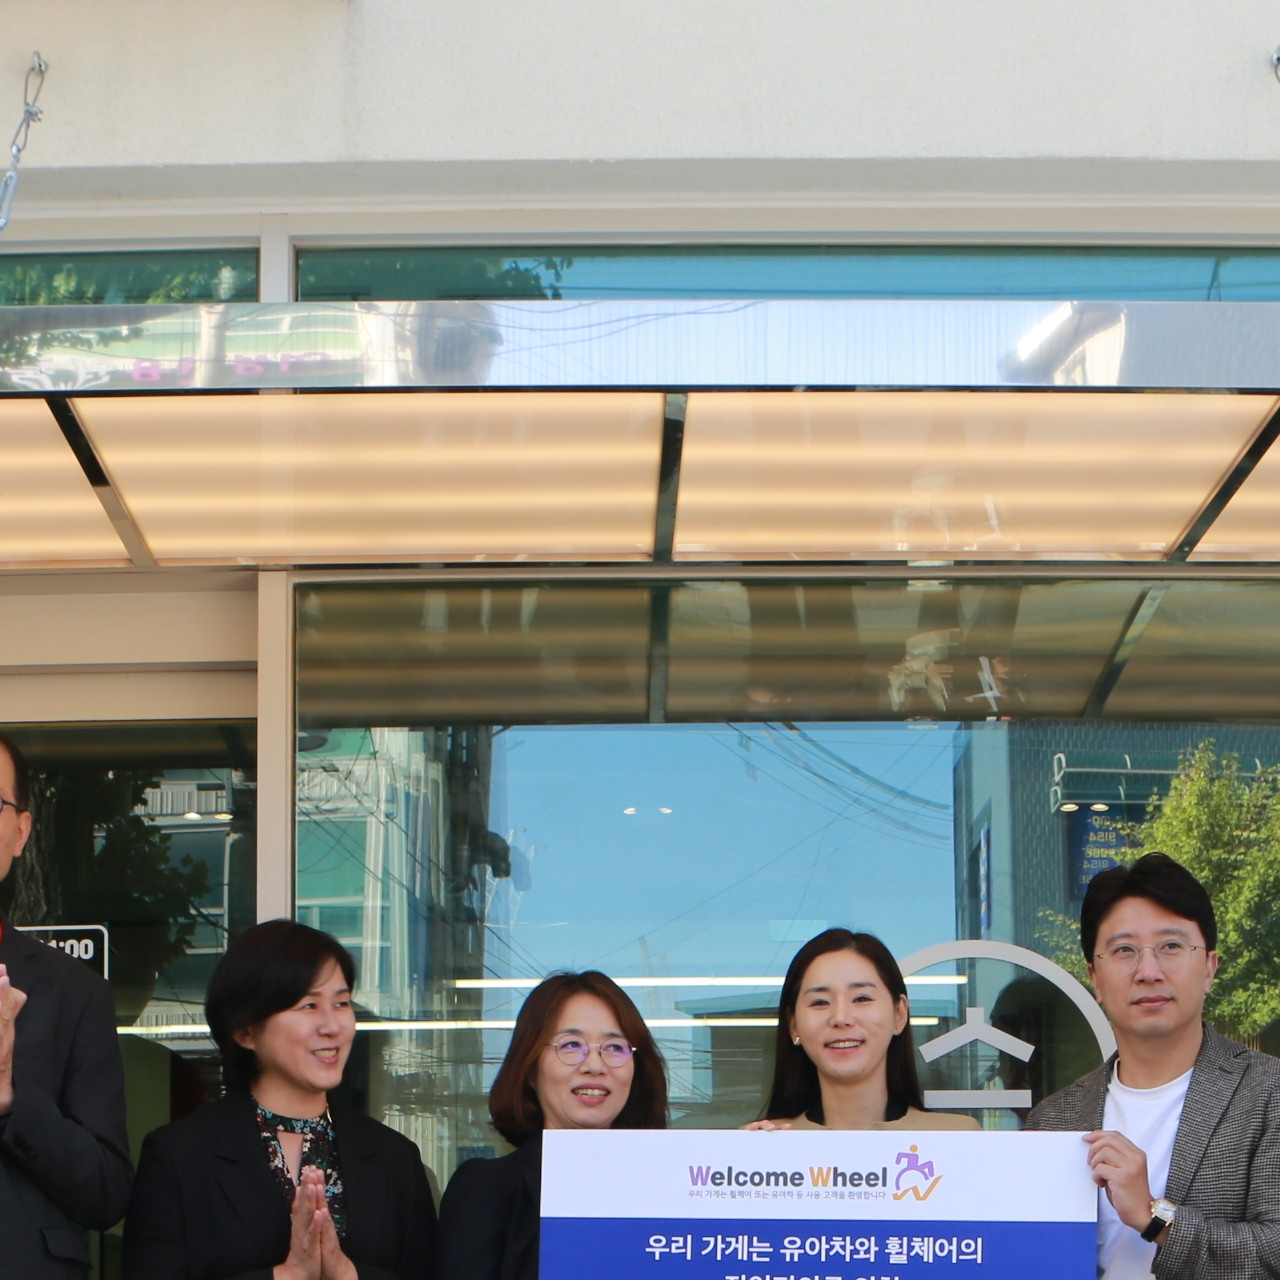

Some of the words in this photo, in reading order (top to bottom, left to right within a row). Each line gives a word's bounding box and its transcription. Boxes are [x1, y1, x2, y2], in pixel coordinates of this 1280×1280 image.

[40, 938, 94, 960] :00
[688, 1165, 805, 1188] Welcome
[808, 1166, 888, 1189] Wheel
[687, 1189, 703, 1199] 우리
[705, 1189, 728, 1199] 가게는
[729, 1189, 752, 1199] 휠체어
[754, 1190, 769, 1199] 또는
[771, 1190, 794, 1199] 유아차
[796, 1190, 804, 1199] 등
[806, 1190, 820, 1199] 사용
[822, 1190, 846, 1200] 고객을
[847, 1190, 886, 1200] 환영합니다
[645, 1234, 693, 1261] 우리
[701, 1234, 773, 1262] 가게는
[780, 1235, 878, 1264] 유아차와
[884, 1236, 984, 1264] 휠체어의
